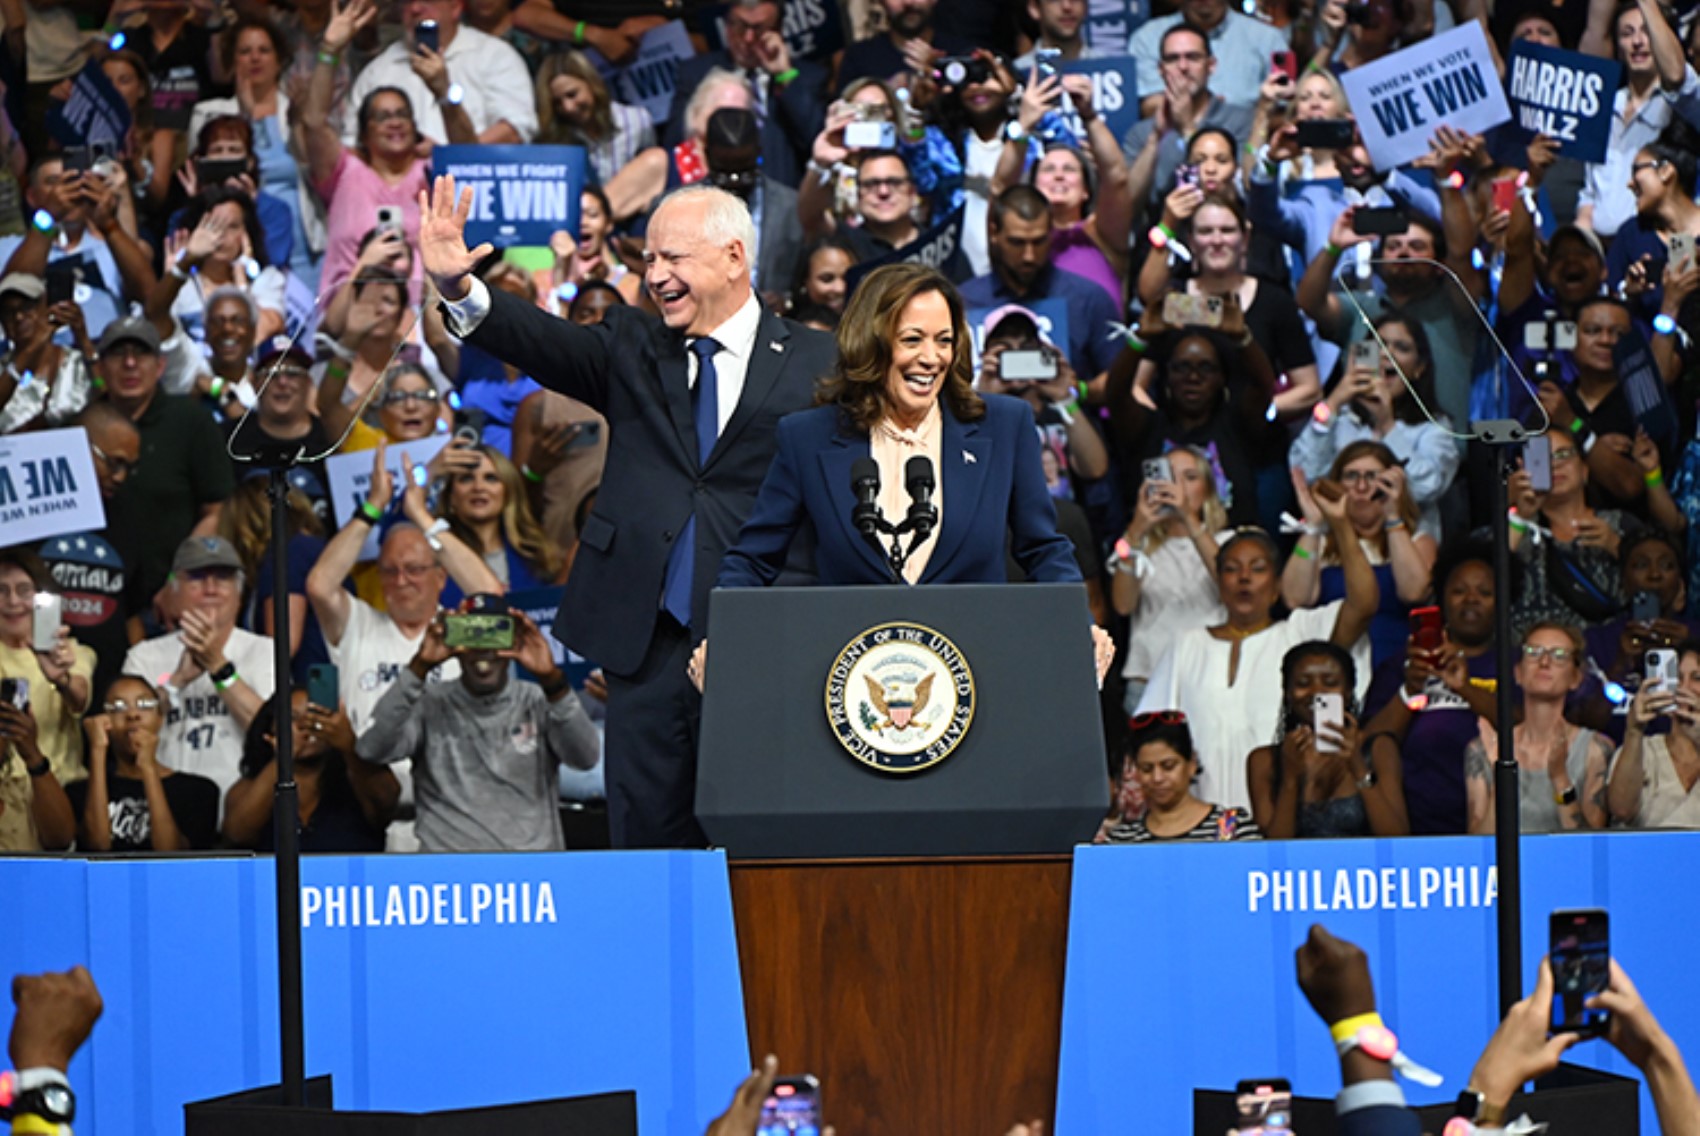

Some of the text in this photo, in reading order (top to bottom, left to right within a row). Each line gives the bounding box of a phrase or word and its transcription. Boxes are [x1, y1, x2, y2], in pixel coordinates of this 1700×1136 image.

[1368, 47, 1472, 97] WHEN WE VOTE
[1510, 55, 1603, 118] HARRIS
[1371, 61, 1488, 138] WE WIN
[1520, 104, 1579, 141] WALZ
[495, 164, 519, 177] WE
[521, 164, 567, 178] FIGHT
[499, 180, 568, 221] WIN
[20, 456, 79, 500] WE
[28, 497, 77, 516] WHEN
[873, 629, 893, 644] OF
[897, 628, 924, 643] THE
[828, 638, 869, 725] PRESIDENT
[928, 636, 972, 697] UNITED
[187, 723, 215, 750] 47
[844, 728, 878, 763] VICE
[925, 704, 970, 761] STATES
[301, 881, 558, 928] PHILADELPHIA
[1247, 865, 1498, 913] PHILADELPHIA
